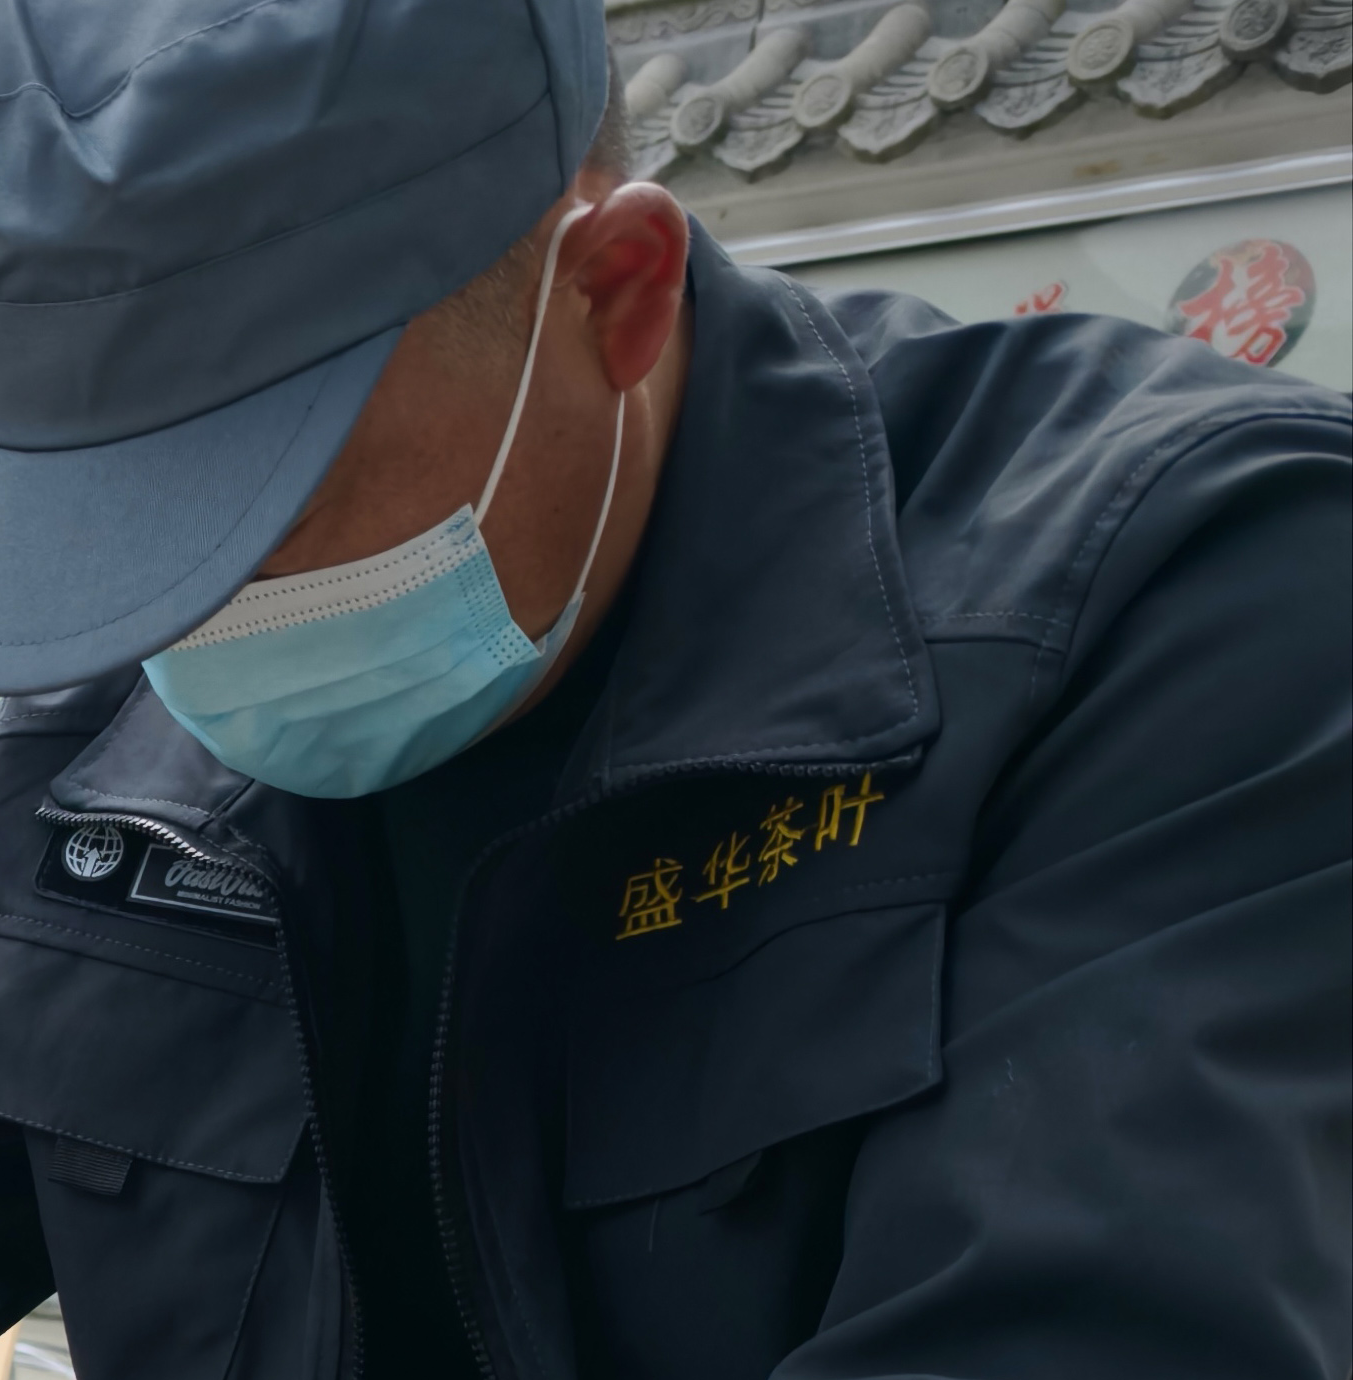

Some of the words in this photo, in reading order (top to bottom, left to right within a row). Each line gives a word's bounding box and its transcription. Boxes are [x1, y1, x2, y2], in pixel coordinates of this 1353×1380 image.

[616, 772, 884, 940] 盛华茶叶
[225, 898, 261, 909] FASHION
